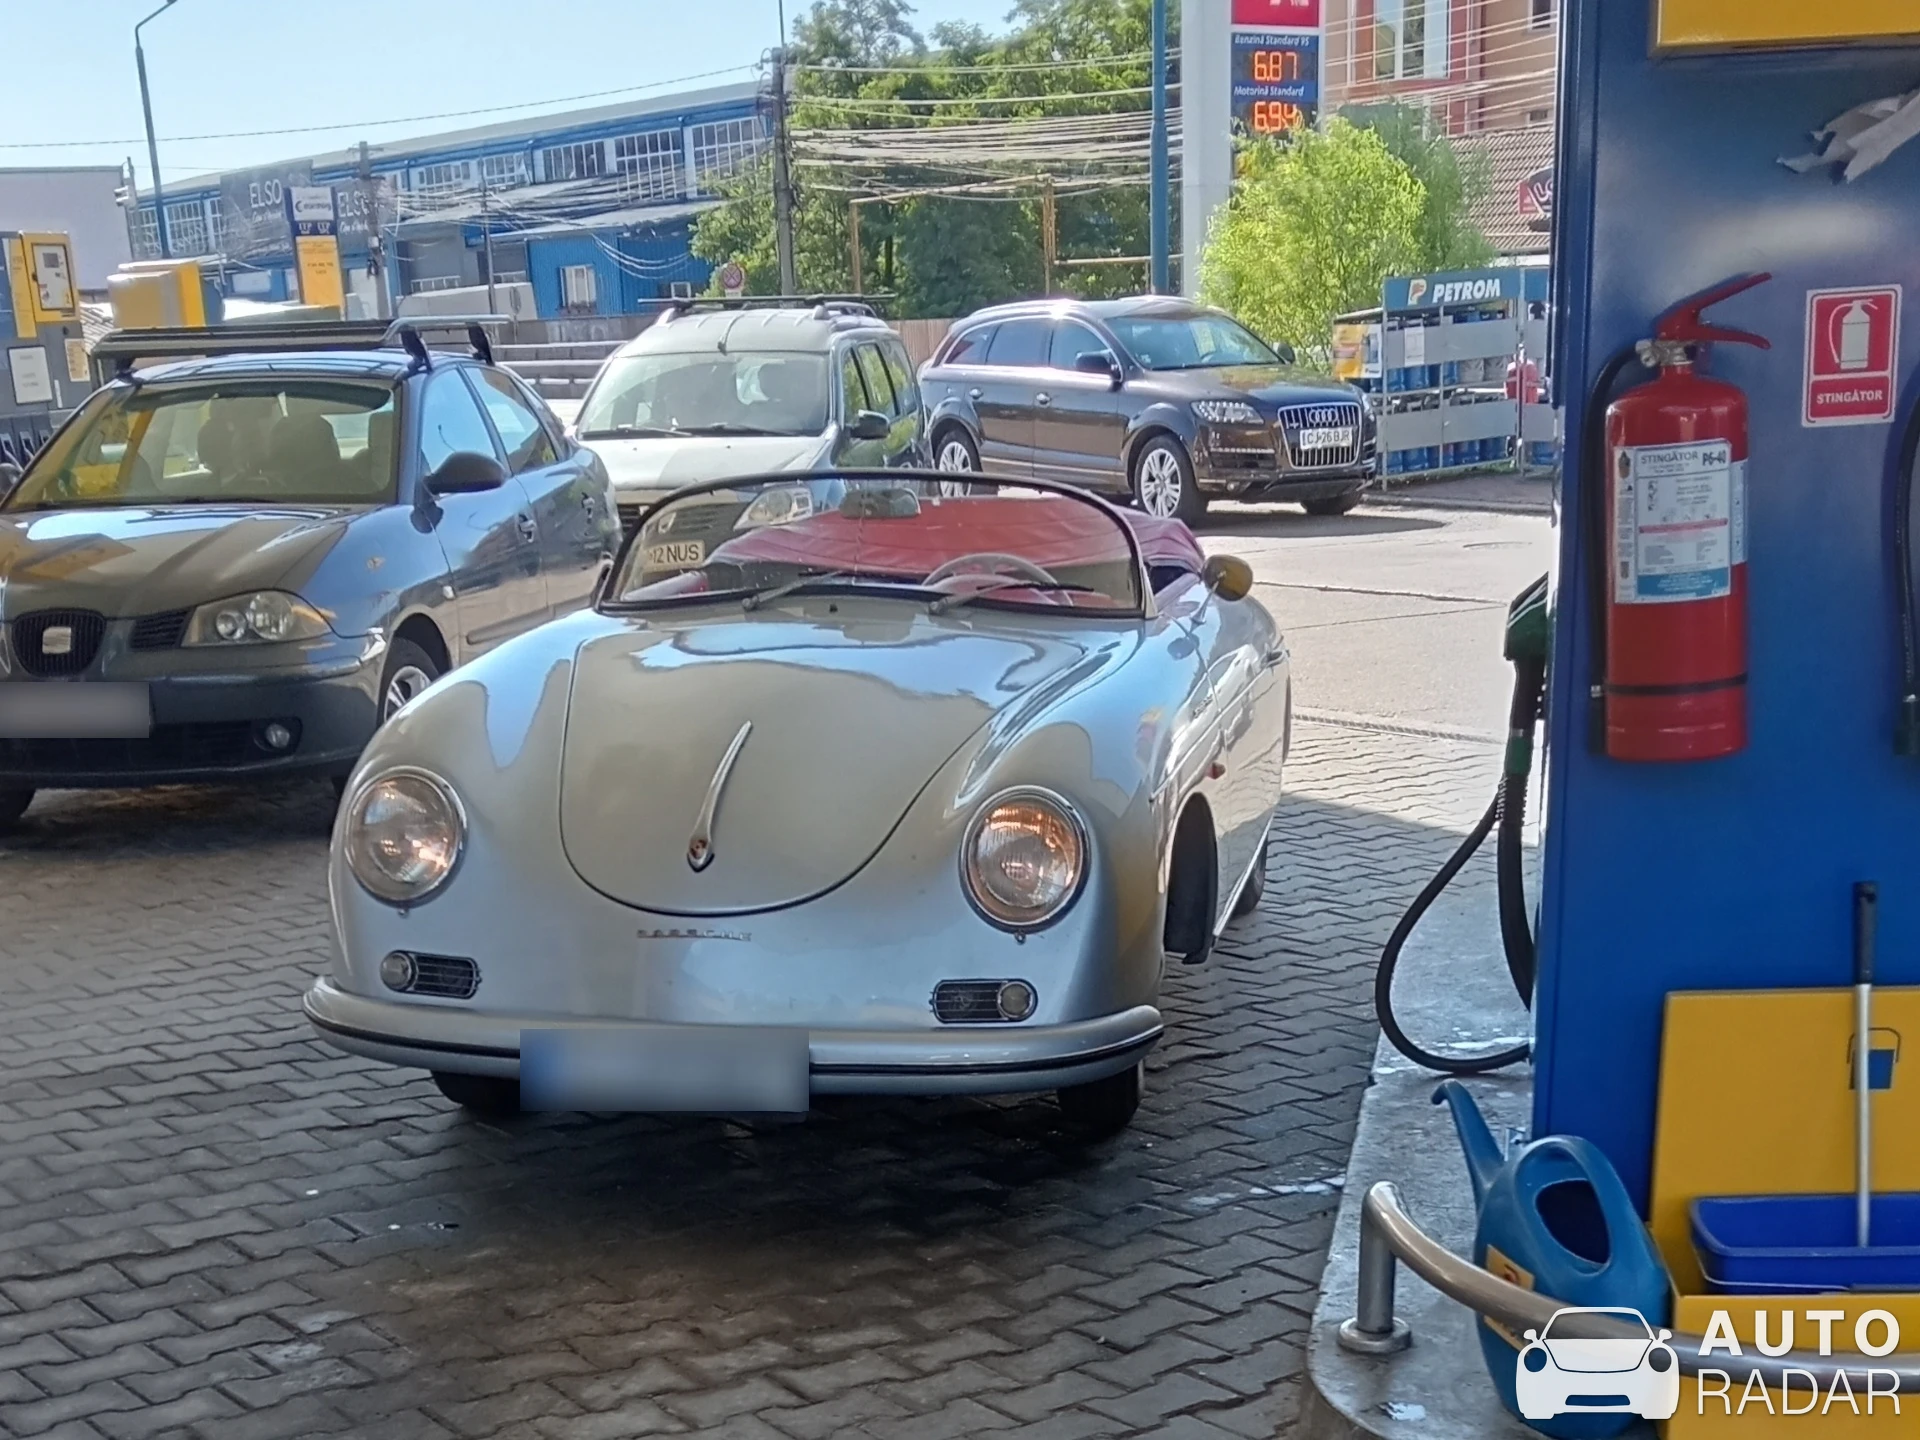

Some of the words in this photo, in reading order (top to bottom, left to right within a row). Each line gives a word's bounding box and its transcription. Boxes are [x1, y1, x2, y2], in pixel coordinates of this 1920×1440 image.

[1265, 35, 1300, 46] Standard
[1269, 86, 1305, 97] Standard
[249, 178, 282, 208] ELSO
[1432, 278, 1500, 303] PETROM
[666, 543, 699, 563] NUS
